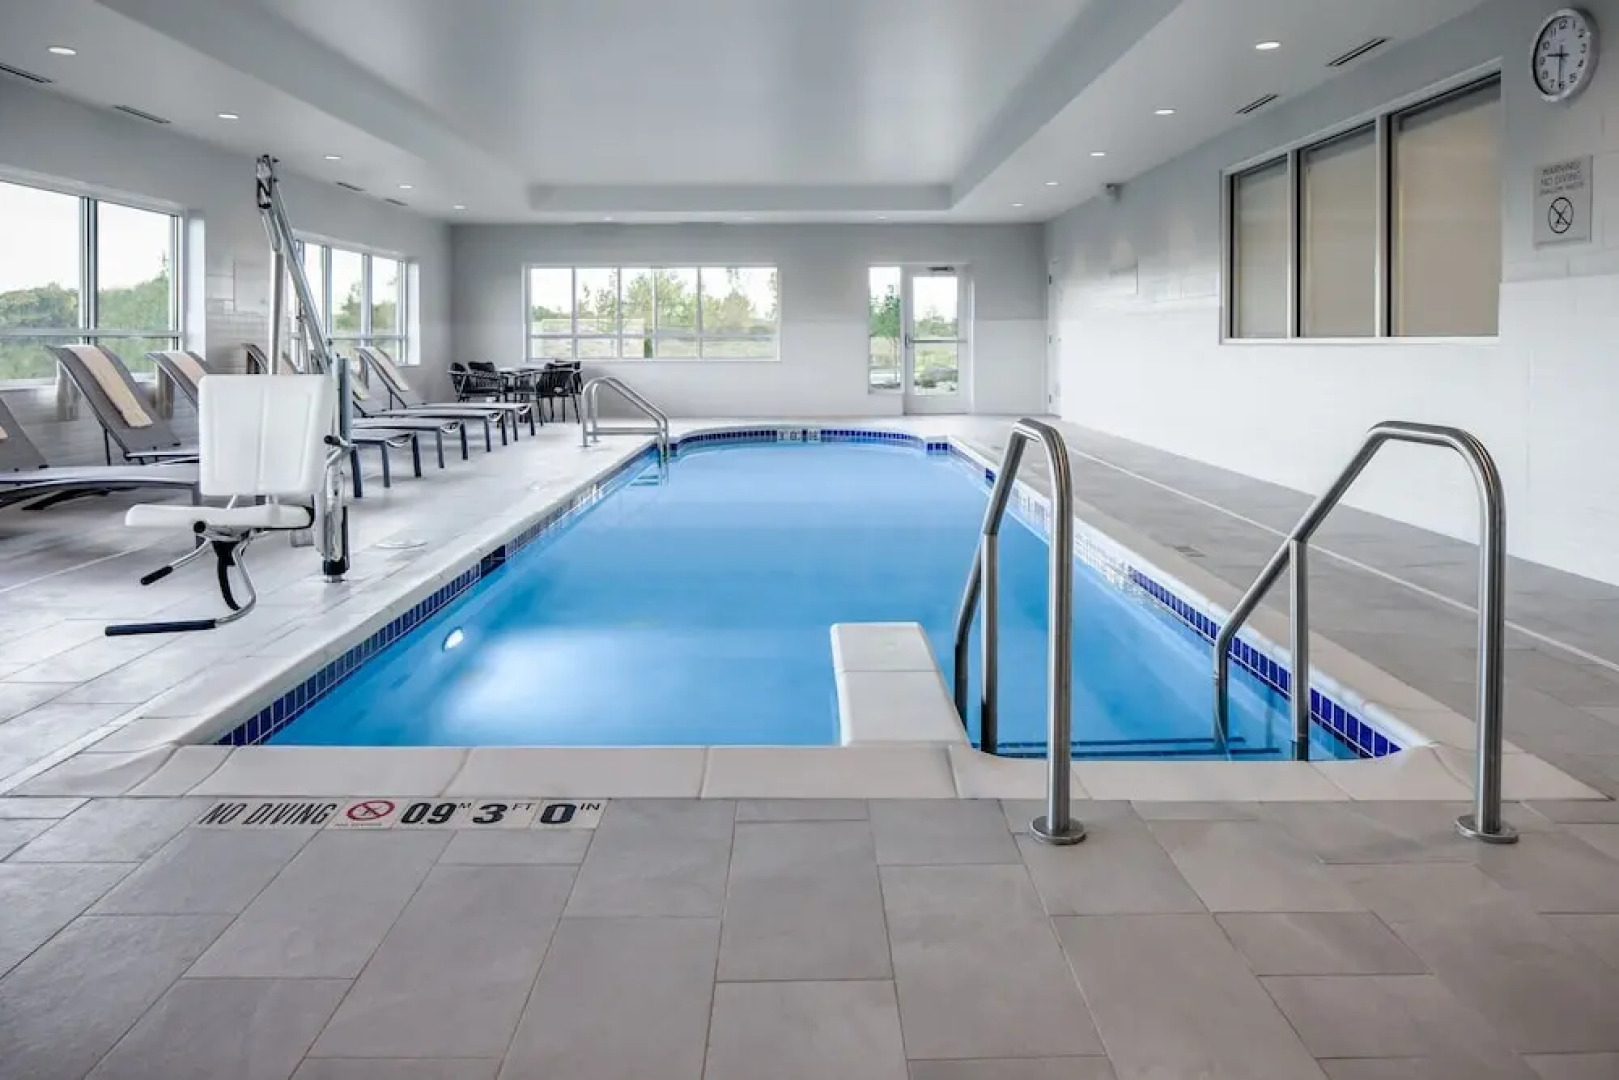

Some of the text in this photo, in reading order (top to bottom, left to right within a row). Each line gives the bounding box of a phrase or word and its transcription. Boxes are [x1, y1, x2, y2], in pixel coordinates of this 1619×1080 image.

[1559, 20, 1567, 29] 12
[1572, 20, 1576, 29] 1
[1550, 27, 1557, 37] 11
[1543, 41, 1550, 51] 10
[1539, 56, 1546, 66] 9
[199, 802, 338, 825] NO DIVING
[472, 803, 508, 825] 3
[511, 802, 537, 811] FT
[540, 803, 577, 825] 0
[580, 802, 601, 811] IN
